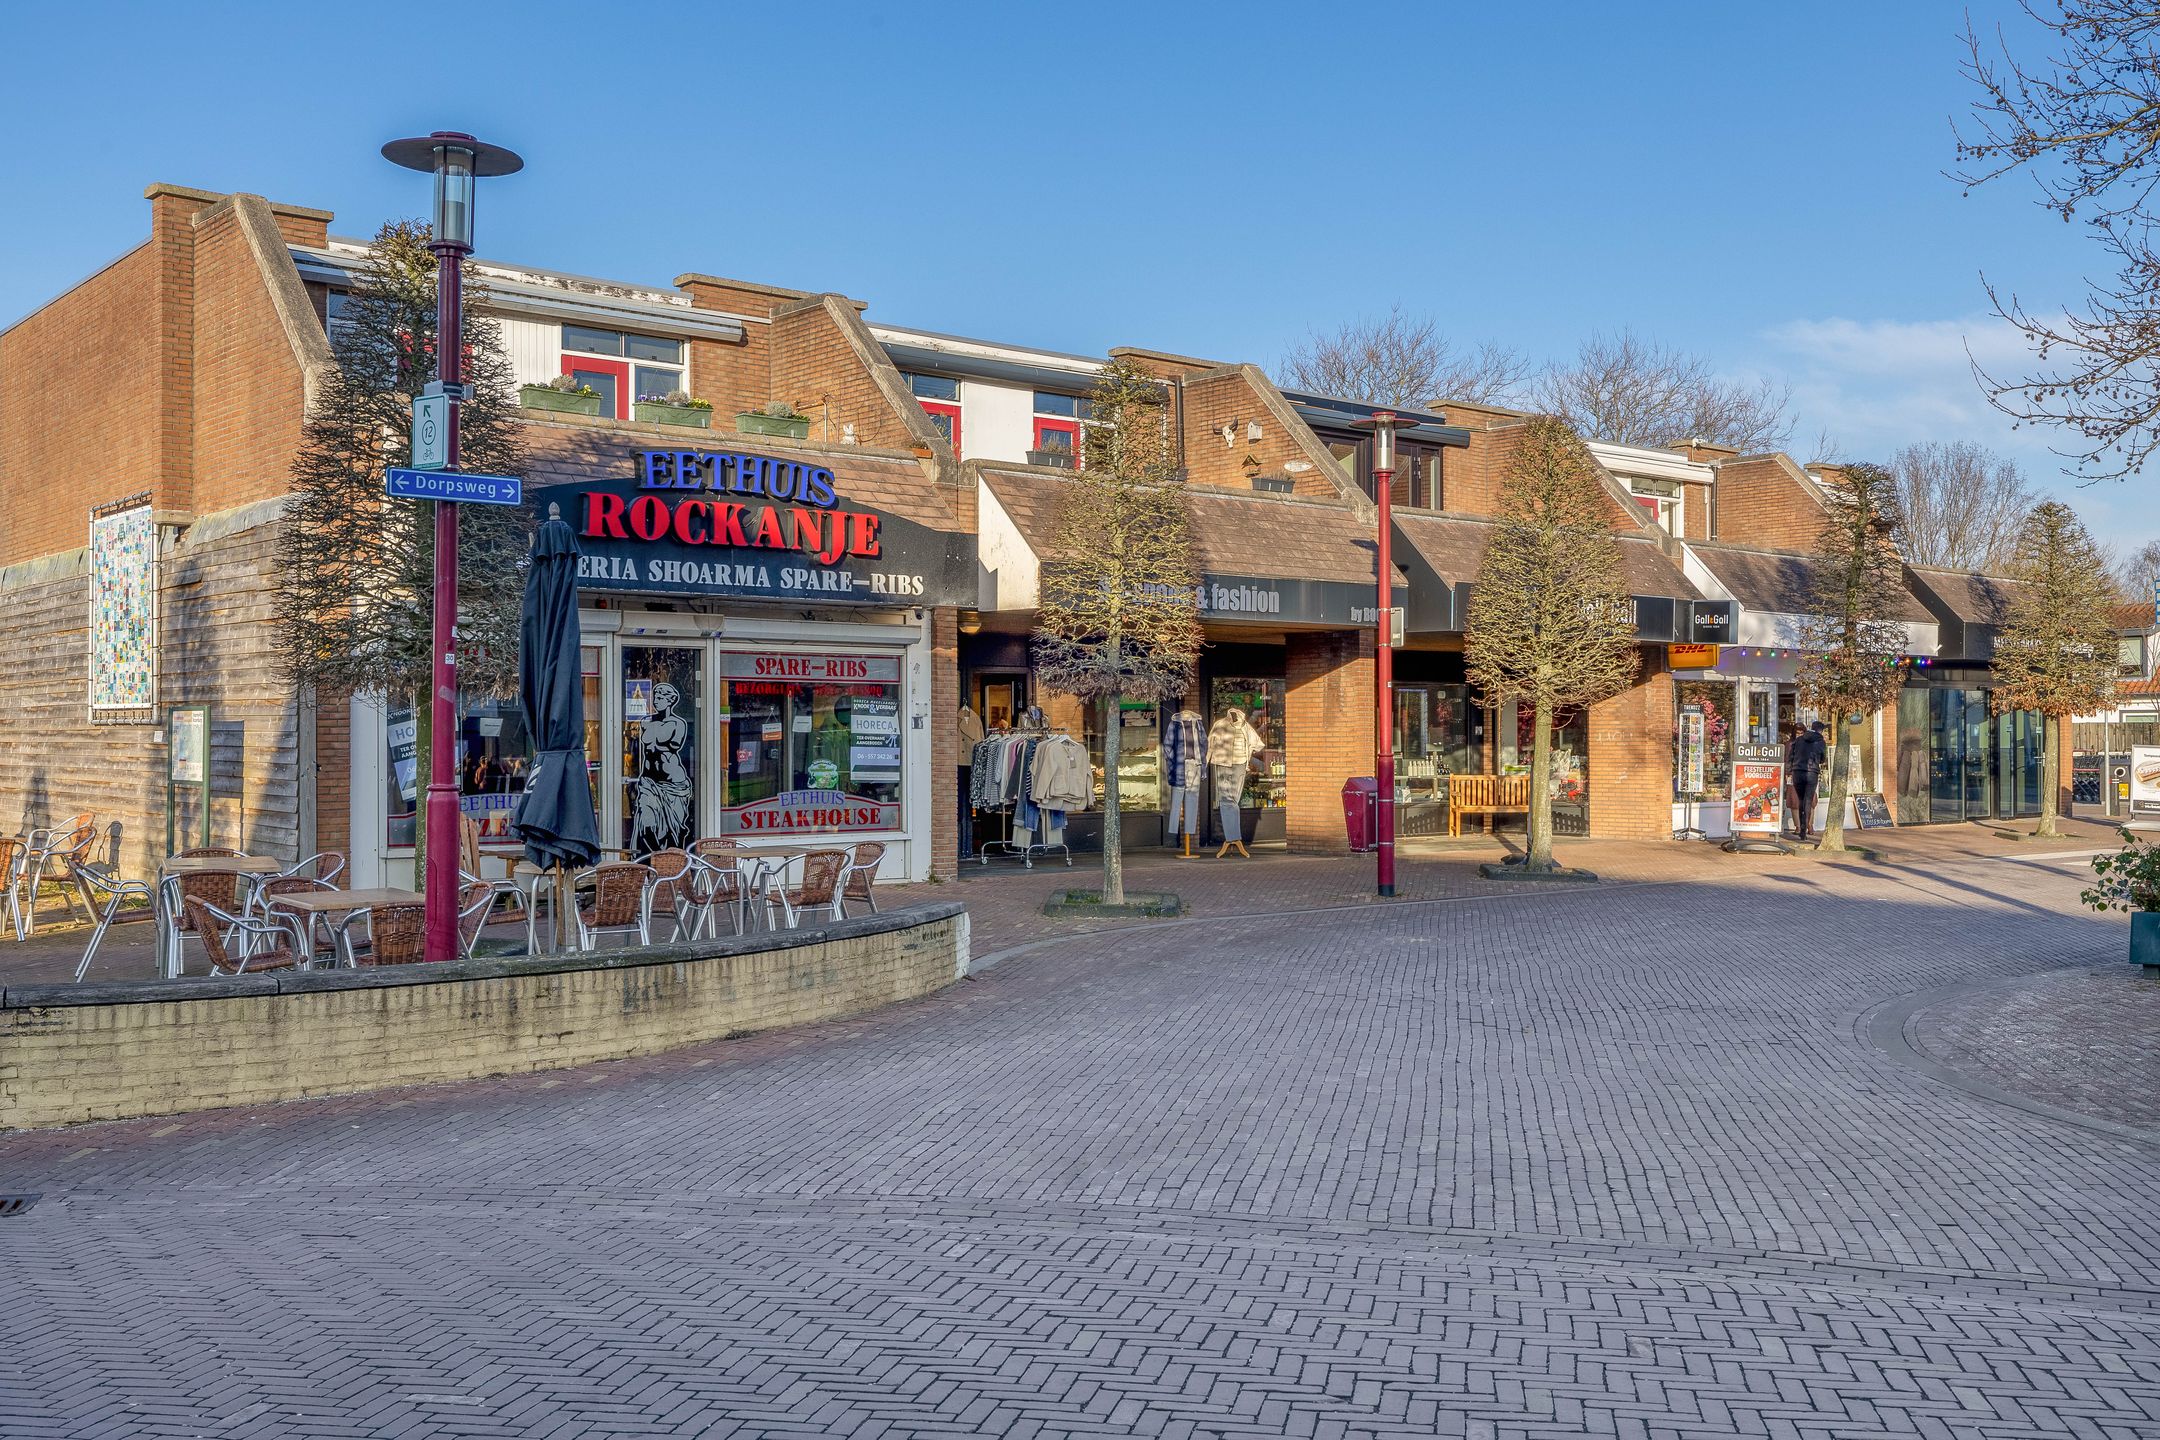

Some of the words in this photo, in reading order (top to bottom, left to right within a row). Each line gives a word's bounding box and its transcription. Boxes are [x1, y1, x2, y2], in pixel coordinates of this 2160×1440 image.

[425, 426, 433, 438] 12
[415, 475, 497, 498] Dorpsweg
[641, 451, 837, 507] EETHUIS
[582, 491, 880, 566] ROCKANJE
[649, 559, 771, 588] SHOARMA
[780, 567, 924, 596] SPARE-RIBS
[1212, 583, 1280, 613] fashion
[1351, 607, 1362, 622] by
[1674, 644, 1708, 654] DHL
[755, 657, 867, 678] SPARE-RIBS
[869, 703, 877, 714] &
[856, 719, 894, 730] HORECA
[780, 791, 845, 807] EETHUIS
[740, 807, 881, 830] STEAKHOUSE
